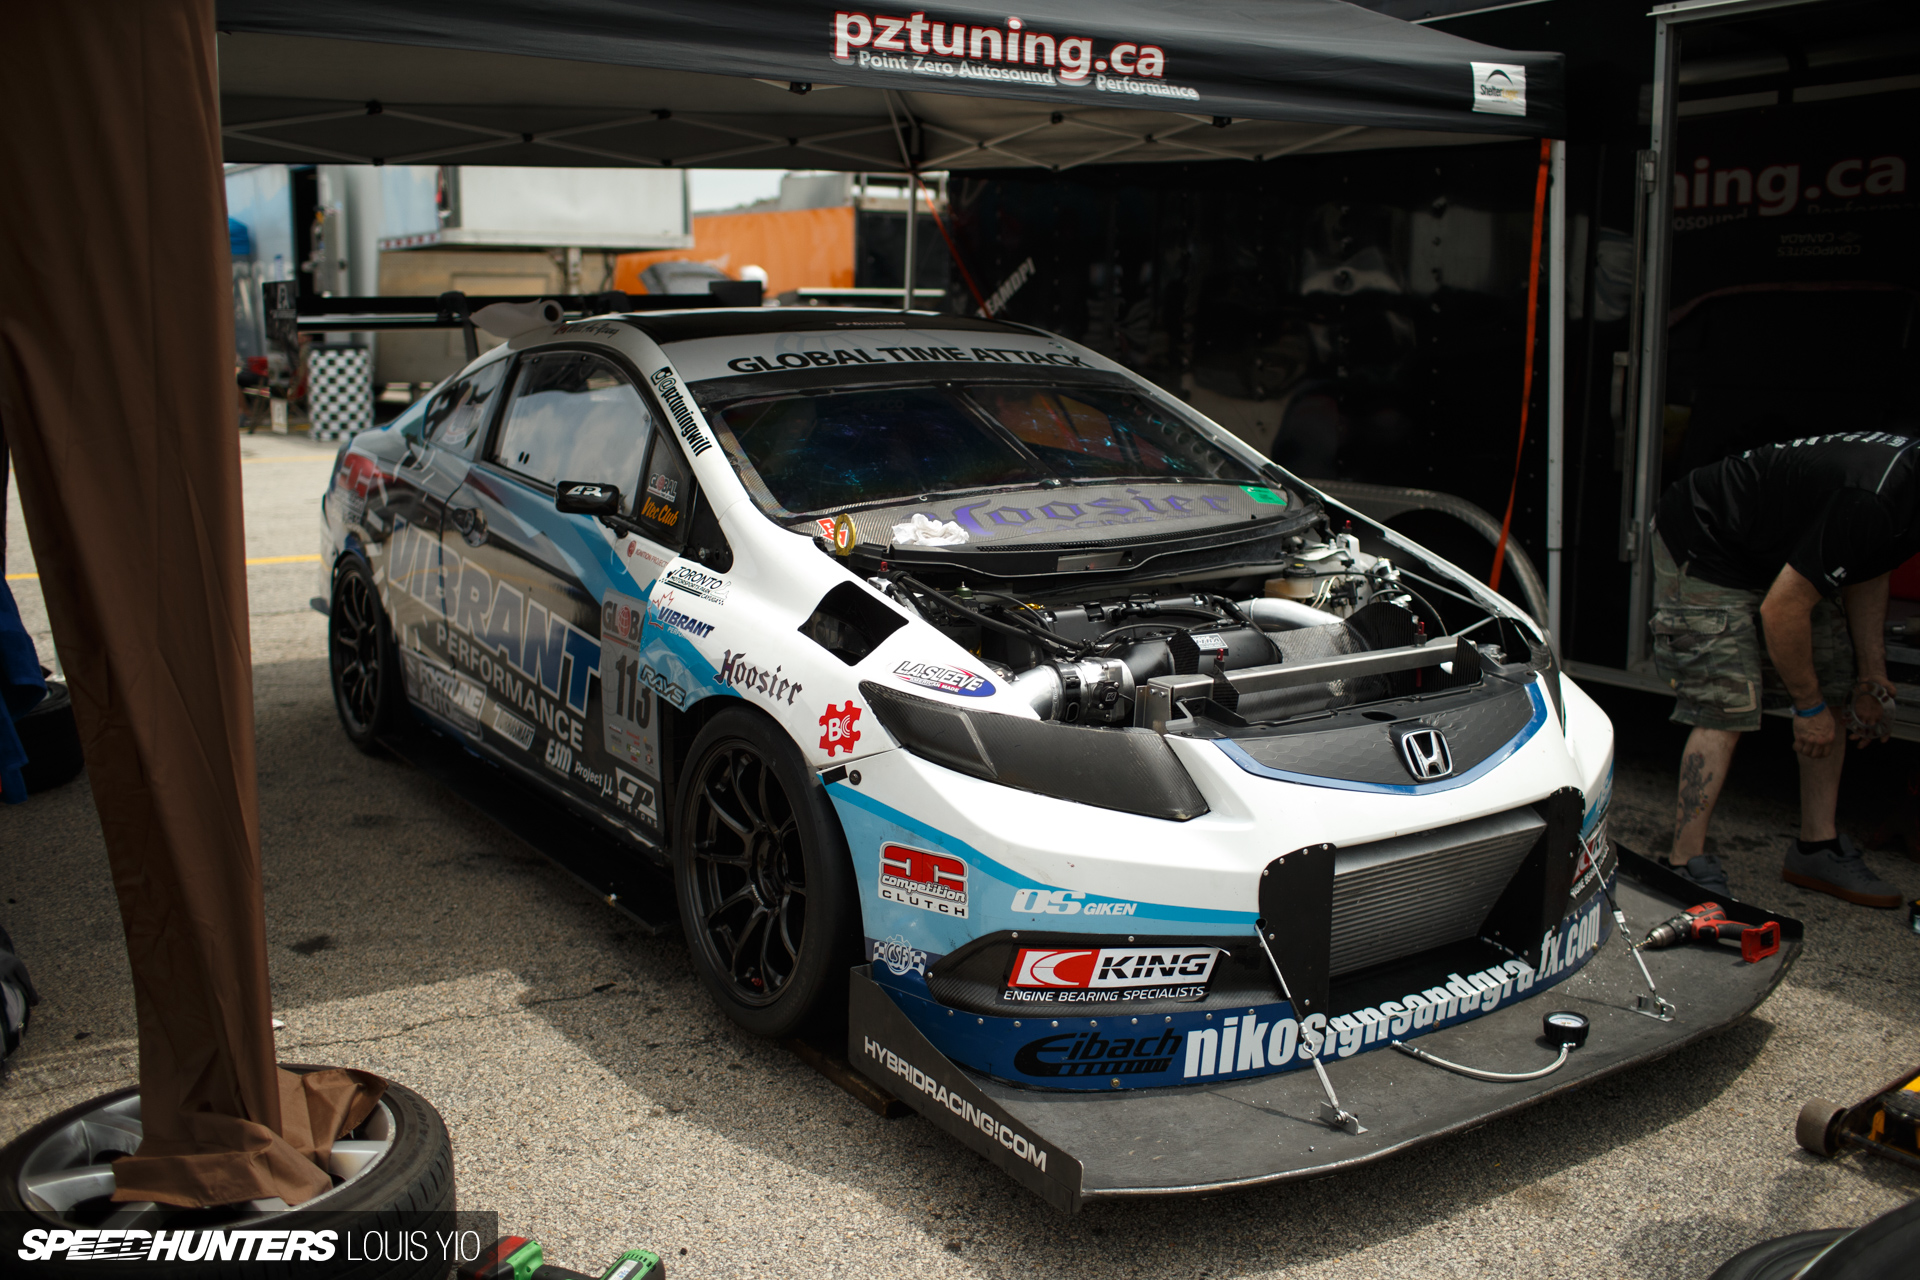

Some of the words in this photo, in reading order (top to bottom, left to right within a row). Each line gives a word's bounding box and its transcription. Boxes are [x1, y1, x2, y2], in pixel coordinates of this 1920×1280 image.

[834, 11, 1165, 79] pztuning.ca
[858, 50, 908, 70] Point
[913, 56, 954, 75] Zero
[960, 61, 1056, 84] Autosound
[1096, 74, 1200, 100] Performance
[728, 349, 881, 373] GLOBAL
[876, 347, 966, 362] TIME
[970, 347, 1095, 369] ATTACK
[657, 504, 680, 527] Club
[673, 566, 723, 590] TORONTO
[388, 513, 601, 719] VIBRANT
[657, 606, 715, 639] VIBRANT
[436, 624, 583, 752] PERFORMANCE
[639, 663, 687, 709] RAYS
[712, 649, 803, 706] Hoosier
[574, 760, 603, 787] Project
[616, 799, 658, 829] PISTONS
[882, 889, 965, 917] CLUTCH
[1010, 888, 1086, 915] OS
[1083, 902, 1137, 917] GIKEN
[887, 943, 909, 967] CSF
[1098, 953, 1211, 980] KING
[1003, 990, 1056, 1002] ENGINE
[1058, 991, 1119, 1003] BEARING
[1122, 986, 1206, 1000] SPECIALISTS
[1014, 1028, 1183, 1077] Eibach
